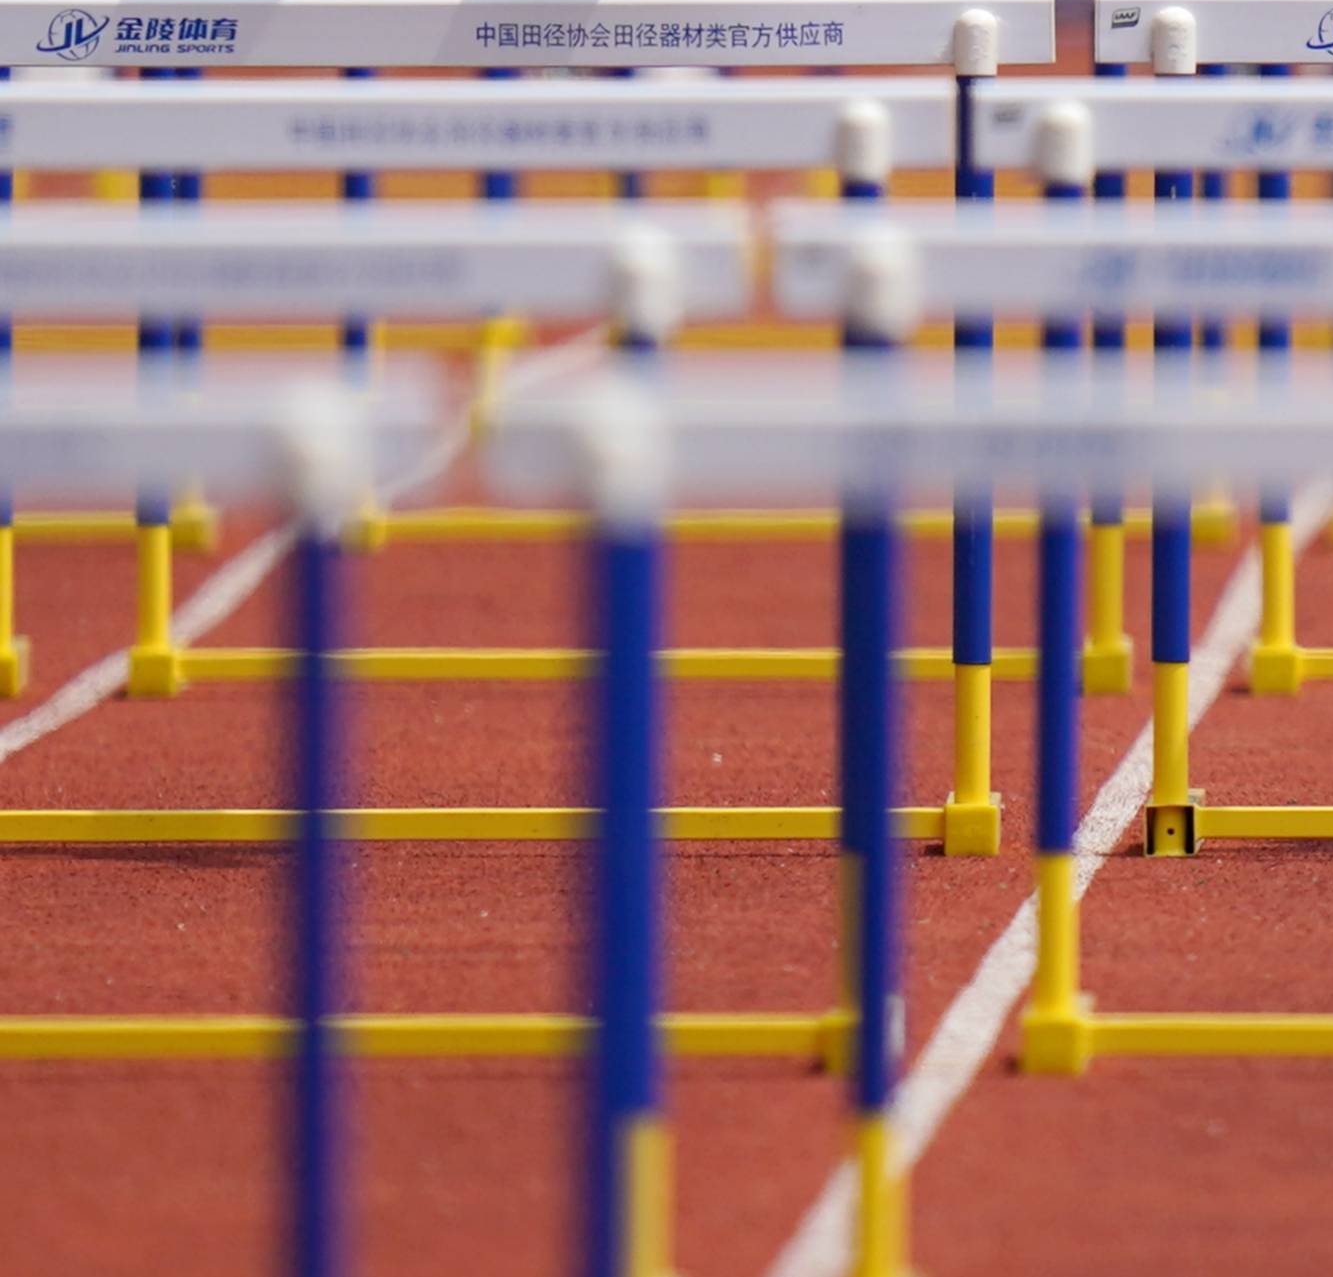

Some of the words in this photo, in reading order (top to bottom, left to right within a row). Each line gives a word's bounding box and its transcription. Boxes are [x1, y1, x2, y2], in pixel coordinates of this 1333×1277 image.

[115, 17, 238, 41] 金陵体育
[475, 20, 844, 49] 中国田径协会田径器材类官方供应商
[115, 43, 170, 53] JINLING
[177, 43, 235, 53] SPORTS
